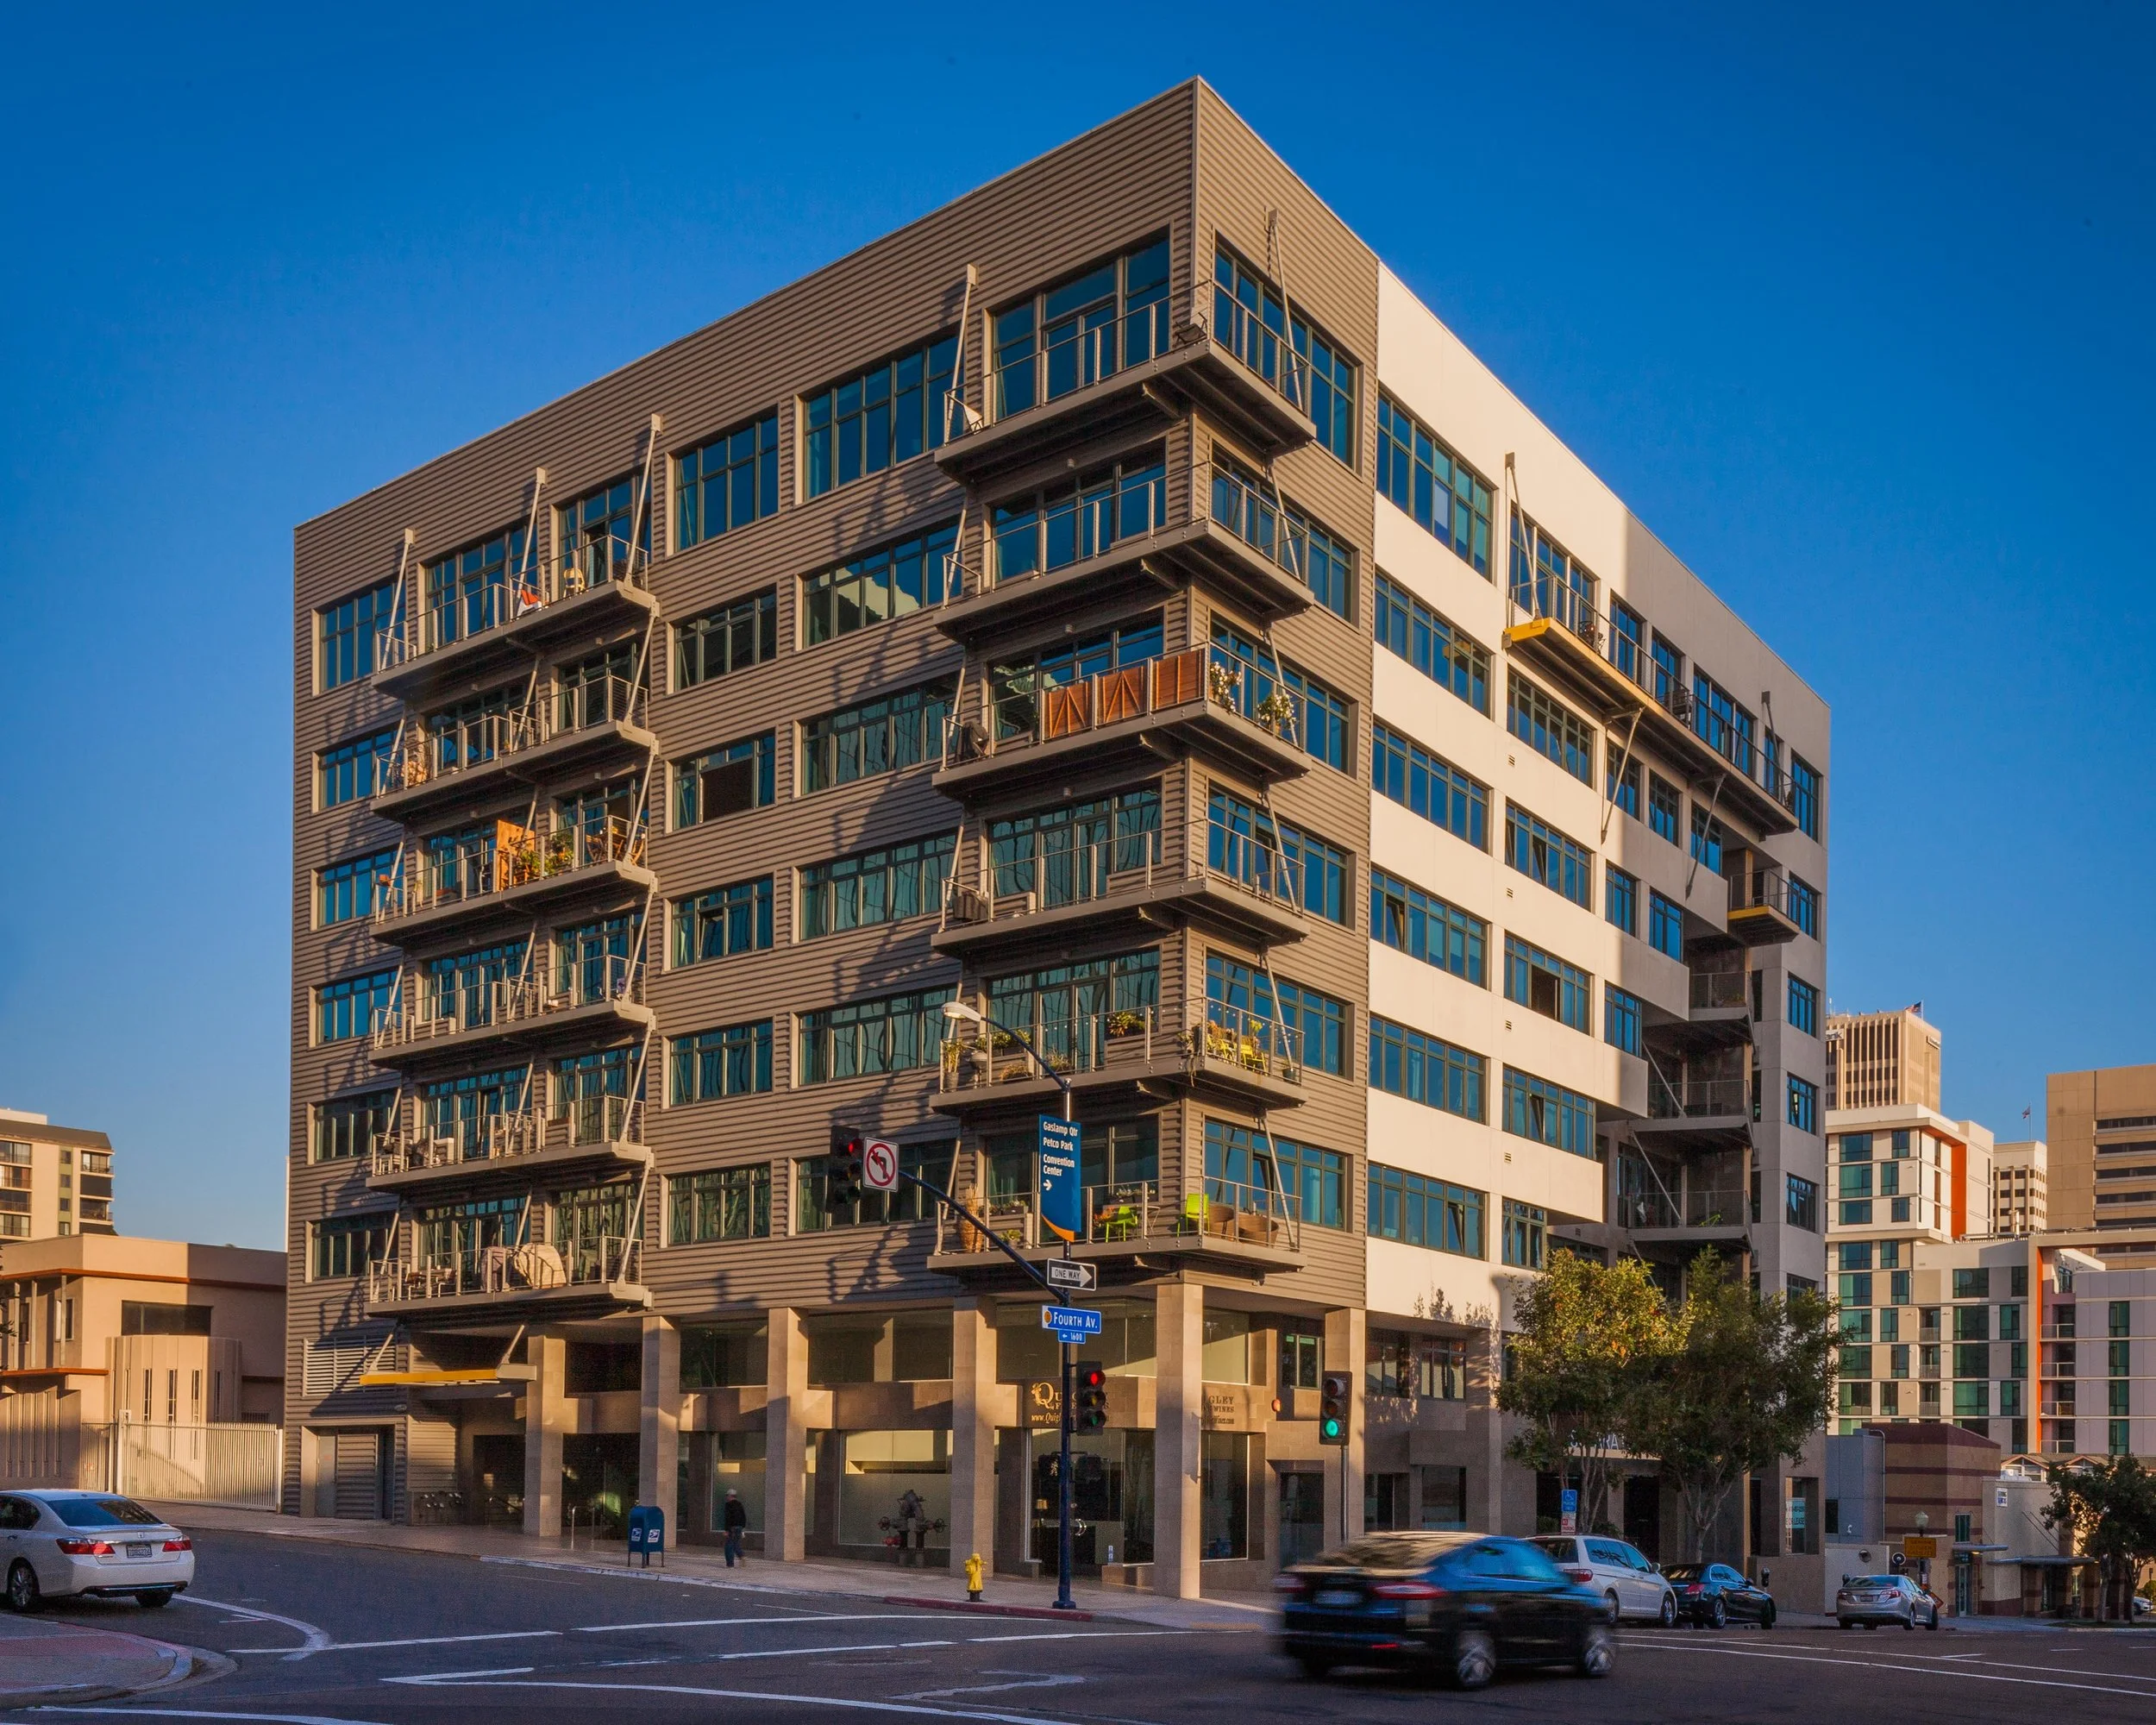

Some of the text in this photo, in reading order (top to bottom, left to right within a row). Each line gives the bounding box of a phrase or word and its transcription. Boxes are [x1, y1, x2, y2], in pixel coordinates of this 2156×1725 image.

[1044, 1121, 1078, 1137] Gaslamp Qtr
[1044, 1137, 1074, 1151] Petco Park
[1044, 1154, 1075, 1168] Convention
[1044, 1164, 1062, 1176] Center
[1055, 1269, 1081, 1279] ONE WAY
